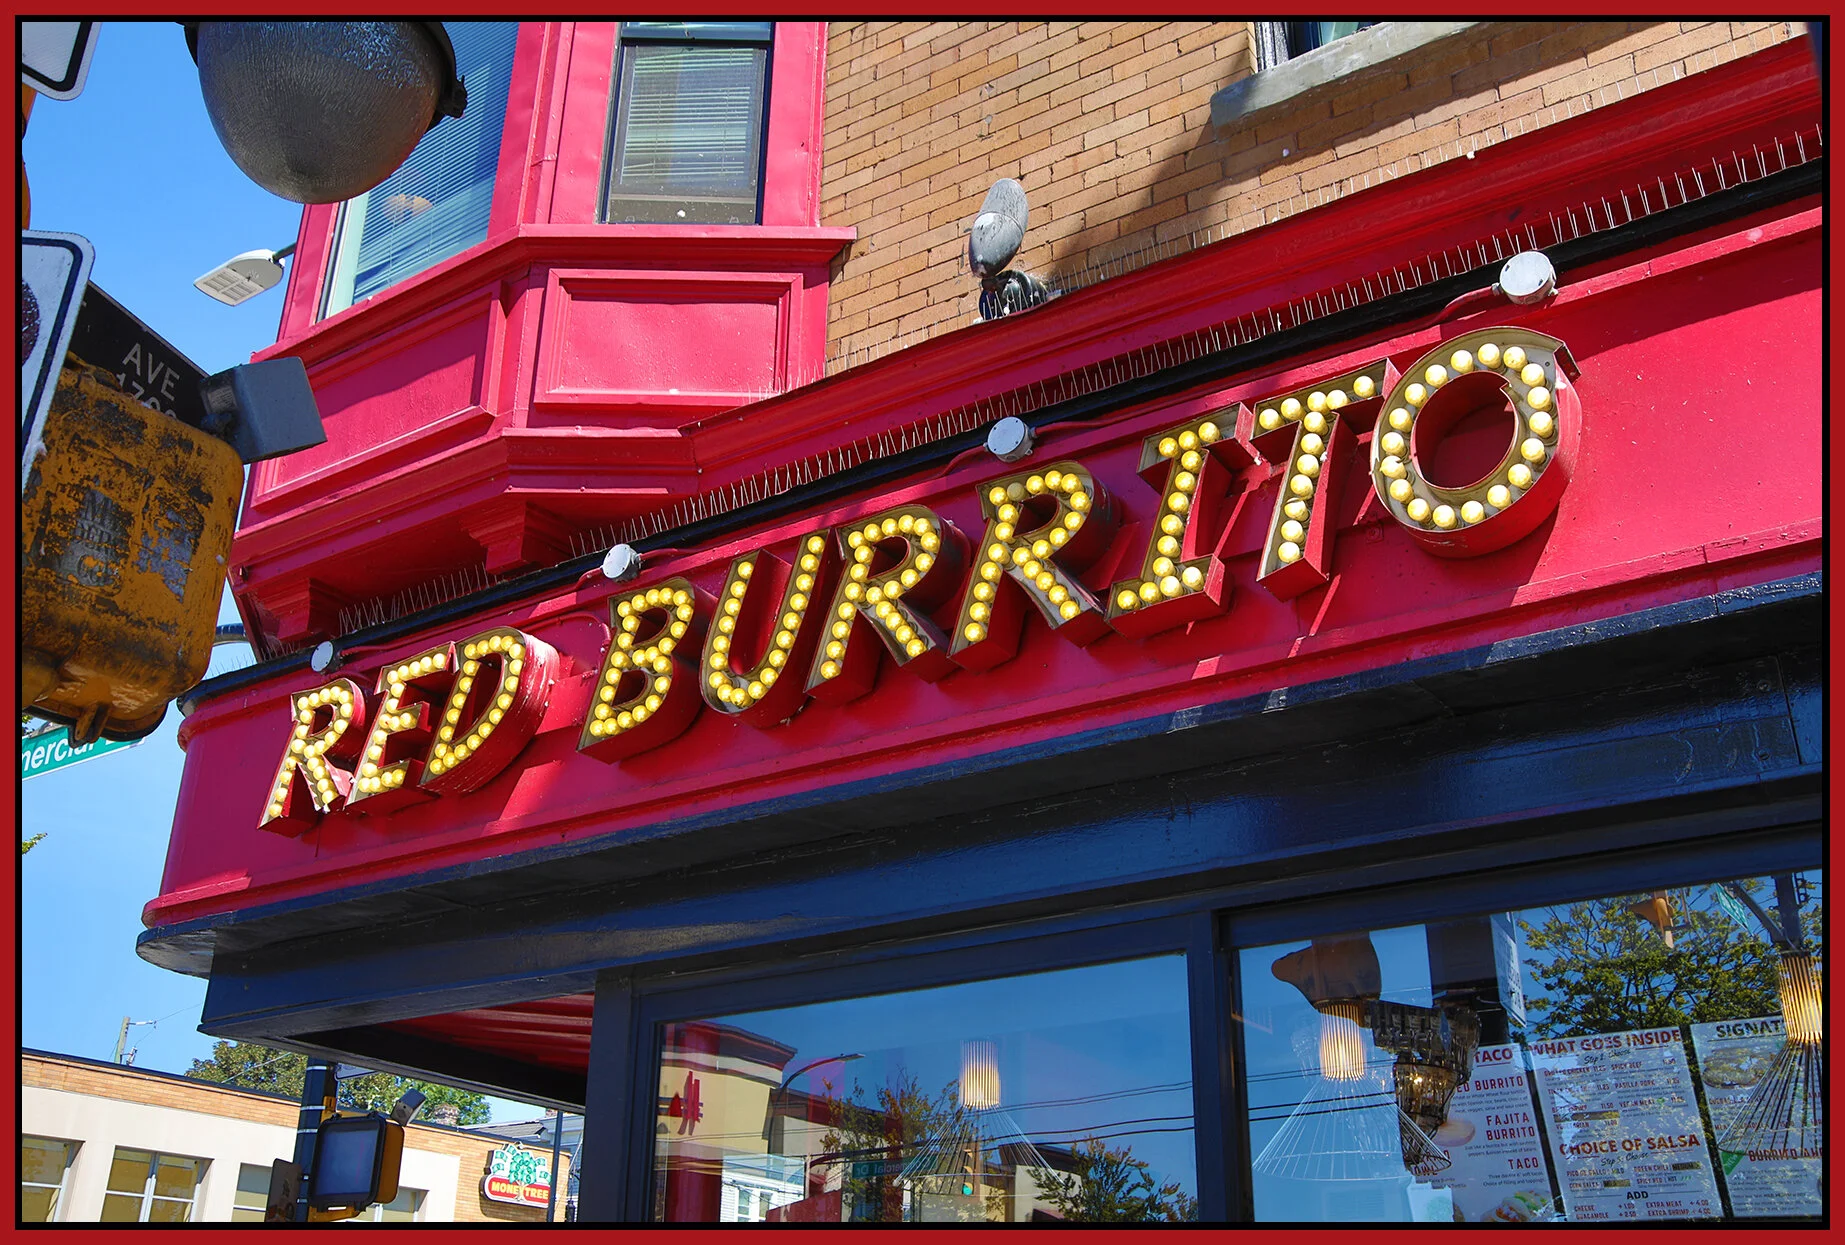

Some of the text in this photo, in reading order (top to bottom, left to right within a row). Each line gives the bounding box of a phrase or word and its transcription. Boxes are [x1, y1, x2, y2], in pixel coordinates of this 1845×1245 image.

[122, 342, 180, 402] AVE
[257, 326, 1572, 832] RED BURRITO
[22, 738, 95, 772] ercia
[1715, 1020, 1783, 1038] SIGNAT
[1528, 1029, 1681, 1055] WHAT GOES INSIDE
[1474, 1047, 1513, 1063] TACO
[1456, 1075, 1524, 1093] ED BURRITO
[1486, 1112, 1530, 1127] FAJITA
[1486, 1126, 1536, 1141] BURRITO
[1559, 1134, 1701, 1156] CHOICE OF SALSA
[1507, 1157, 1539, 1170] TACO
[1748, 1148, 1798, 1162] BURRITO
[490, 1181, 549, 1200] MONEY TREE
[1626, 1190, 1649, 1200] ADD
[1648, 1209, 1666, 1217] EXTRA
